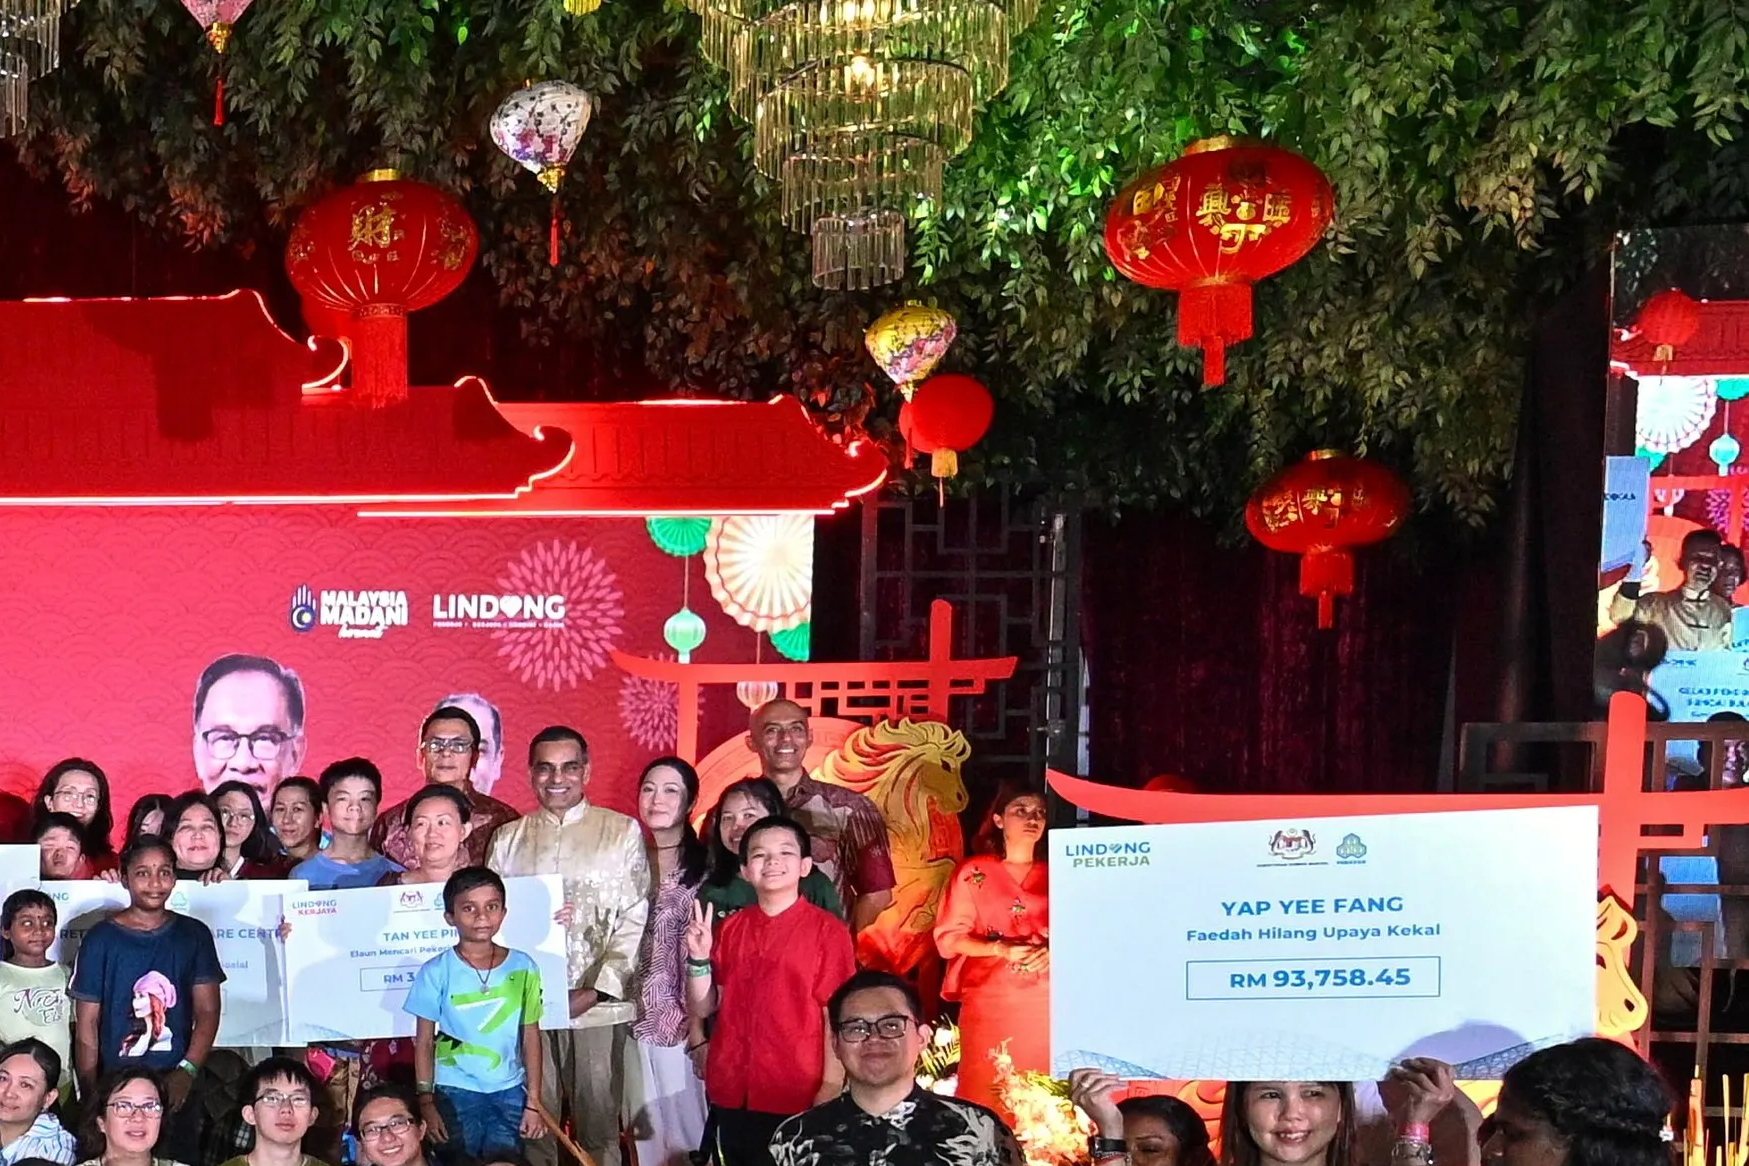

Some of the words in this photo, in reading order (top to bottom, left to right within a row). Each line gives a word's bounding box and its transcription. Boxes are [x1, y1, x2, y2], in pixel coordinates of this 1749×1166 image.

[320, 590, 407, 607] MALAYSIA
[320, 604, 409, 625] MADANI
[1073, 855, 1150, 868] PEKERJA
[1221, 901, 1270, 916] YAP
[1280, 899, 1325, 915] YEE
[1334, 896, 1403, 913] FANG
[383, 931, 409, 941] TAN
[413, 930, 438, 939] YEE
[1186, 927, 1252, 942] Faedah
[1258, 925, 1317, 942] Hilang
[1323, 925, 1381, 941] Upaya
[1388, 922, 1440, 936] Kekal
[382, 974, 403, 983] RM
[1230, 973, 1267, 988] RM
[1273, 968, 1411, 990] 93,758.45
